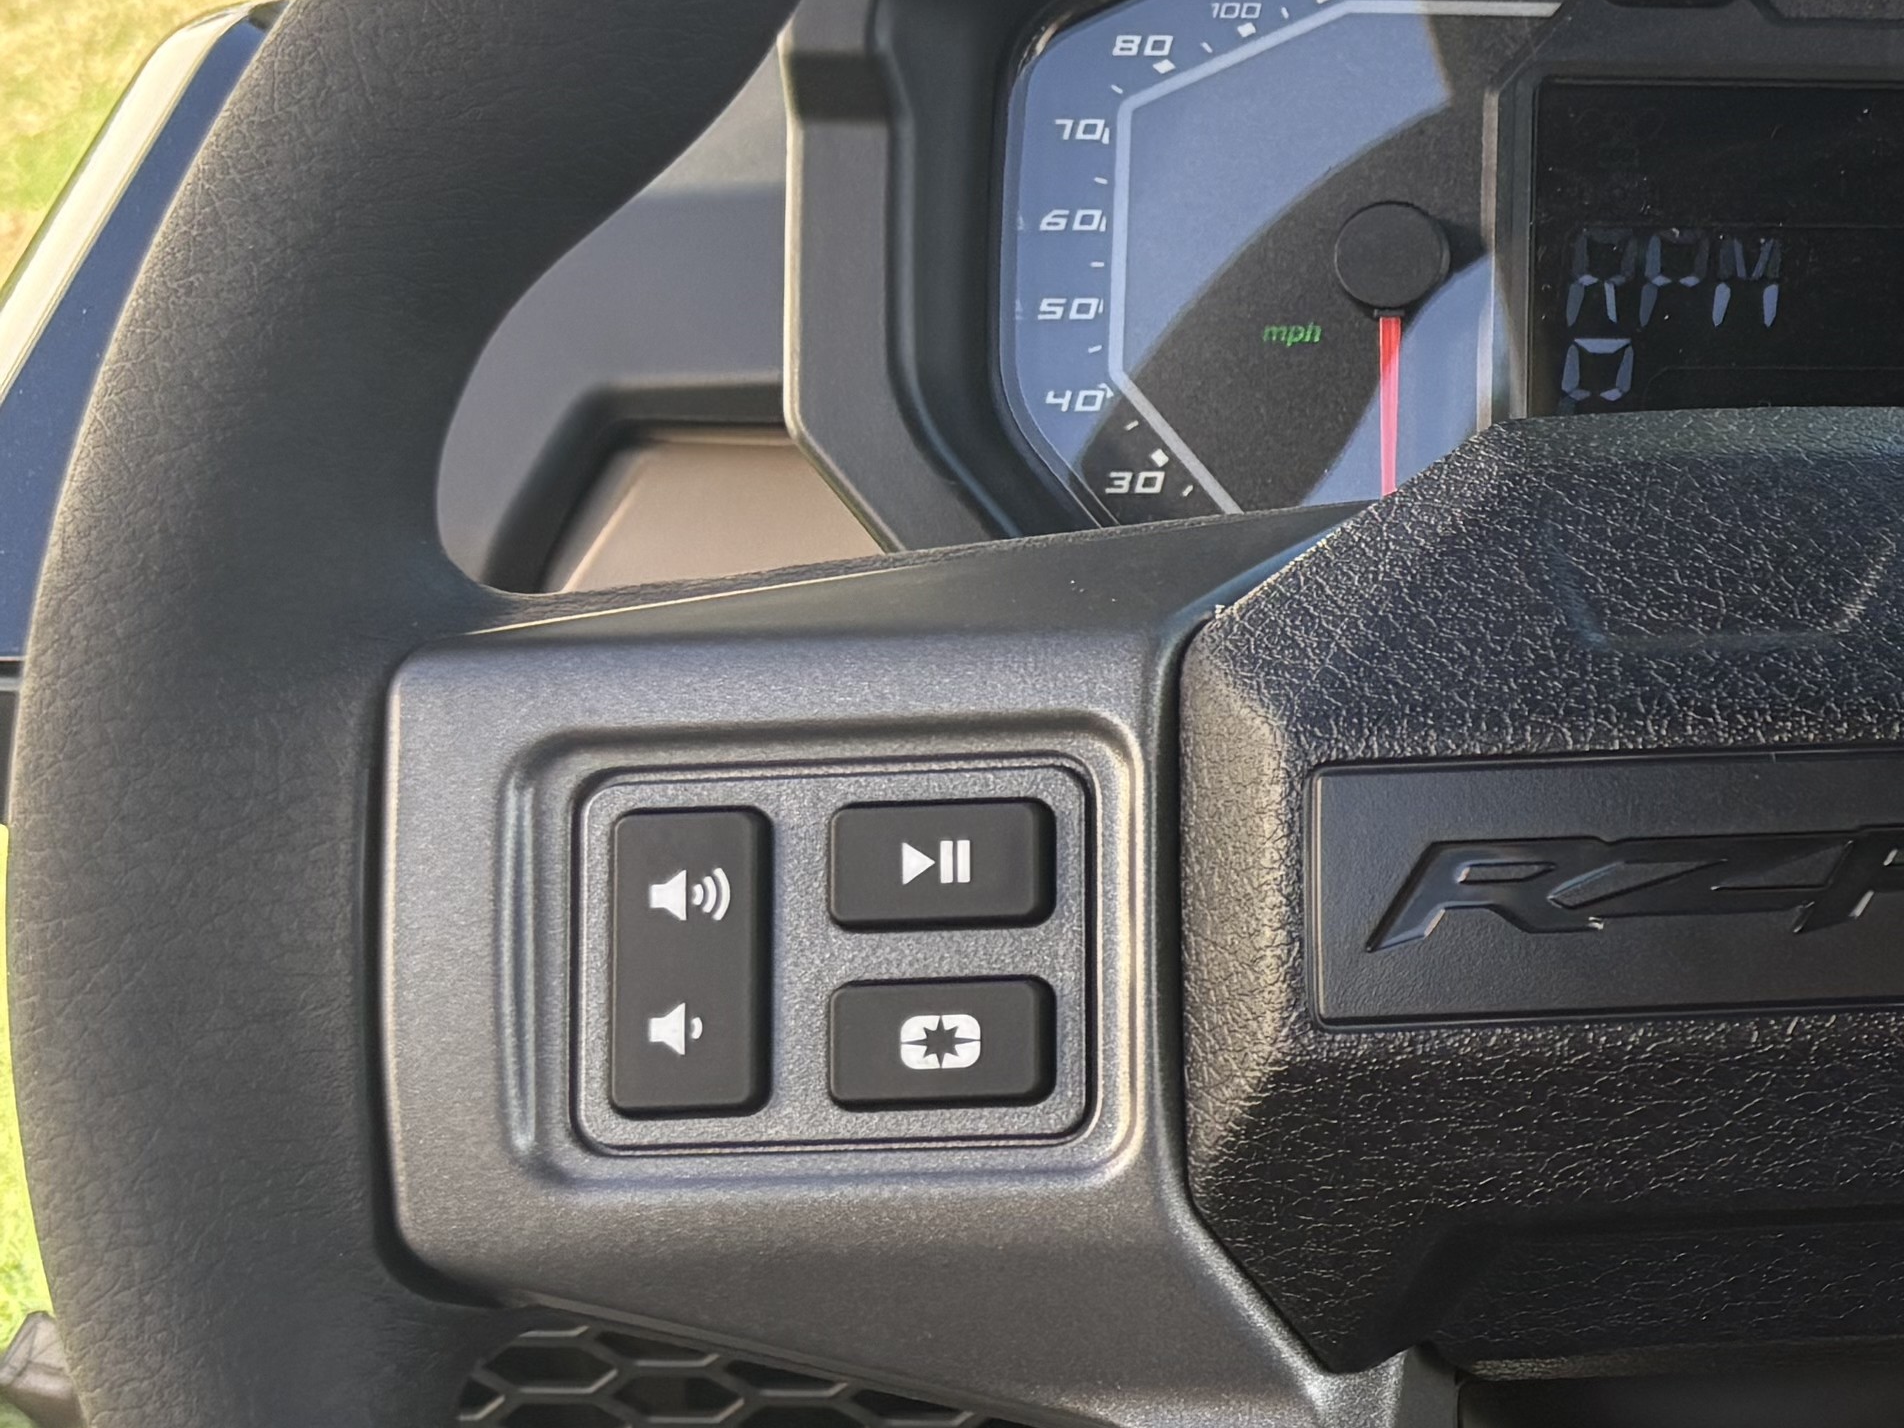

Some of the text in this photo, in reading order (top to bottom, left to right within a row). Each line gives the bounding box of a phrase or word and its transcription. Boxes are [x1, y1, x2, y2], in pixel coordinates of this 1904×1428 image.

[1211, 2, 1262, 19] 100
[1112, 35, 1173, 57] 80
[1055, 119, 1104, 141] 70
[1039, 209, 1103, 232] 60
[1038, 298, 1100, 321] 50
[1262, 321, 1323, 347] mph
[1045, 390, 1103, 412] 40
[1105, 471, 1165, 495] 30
